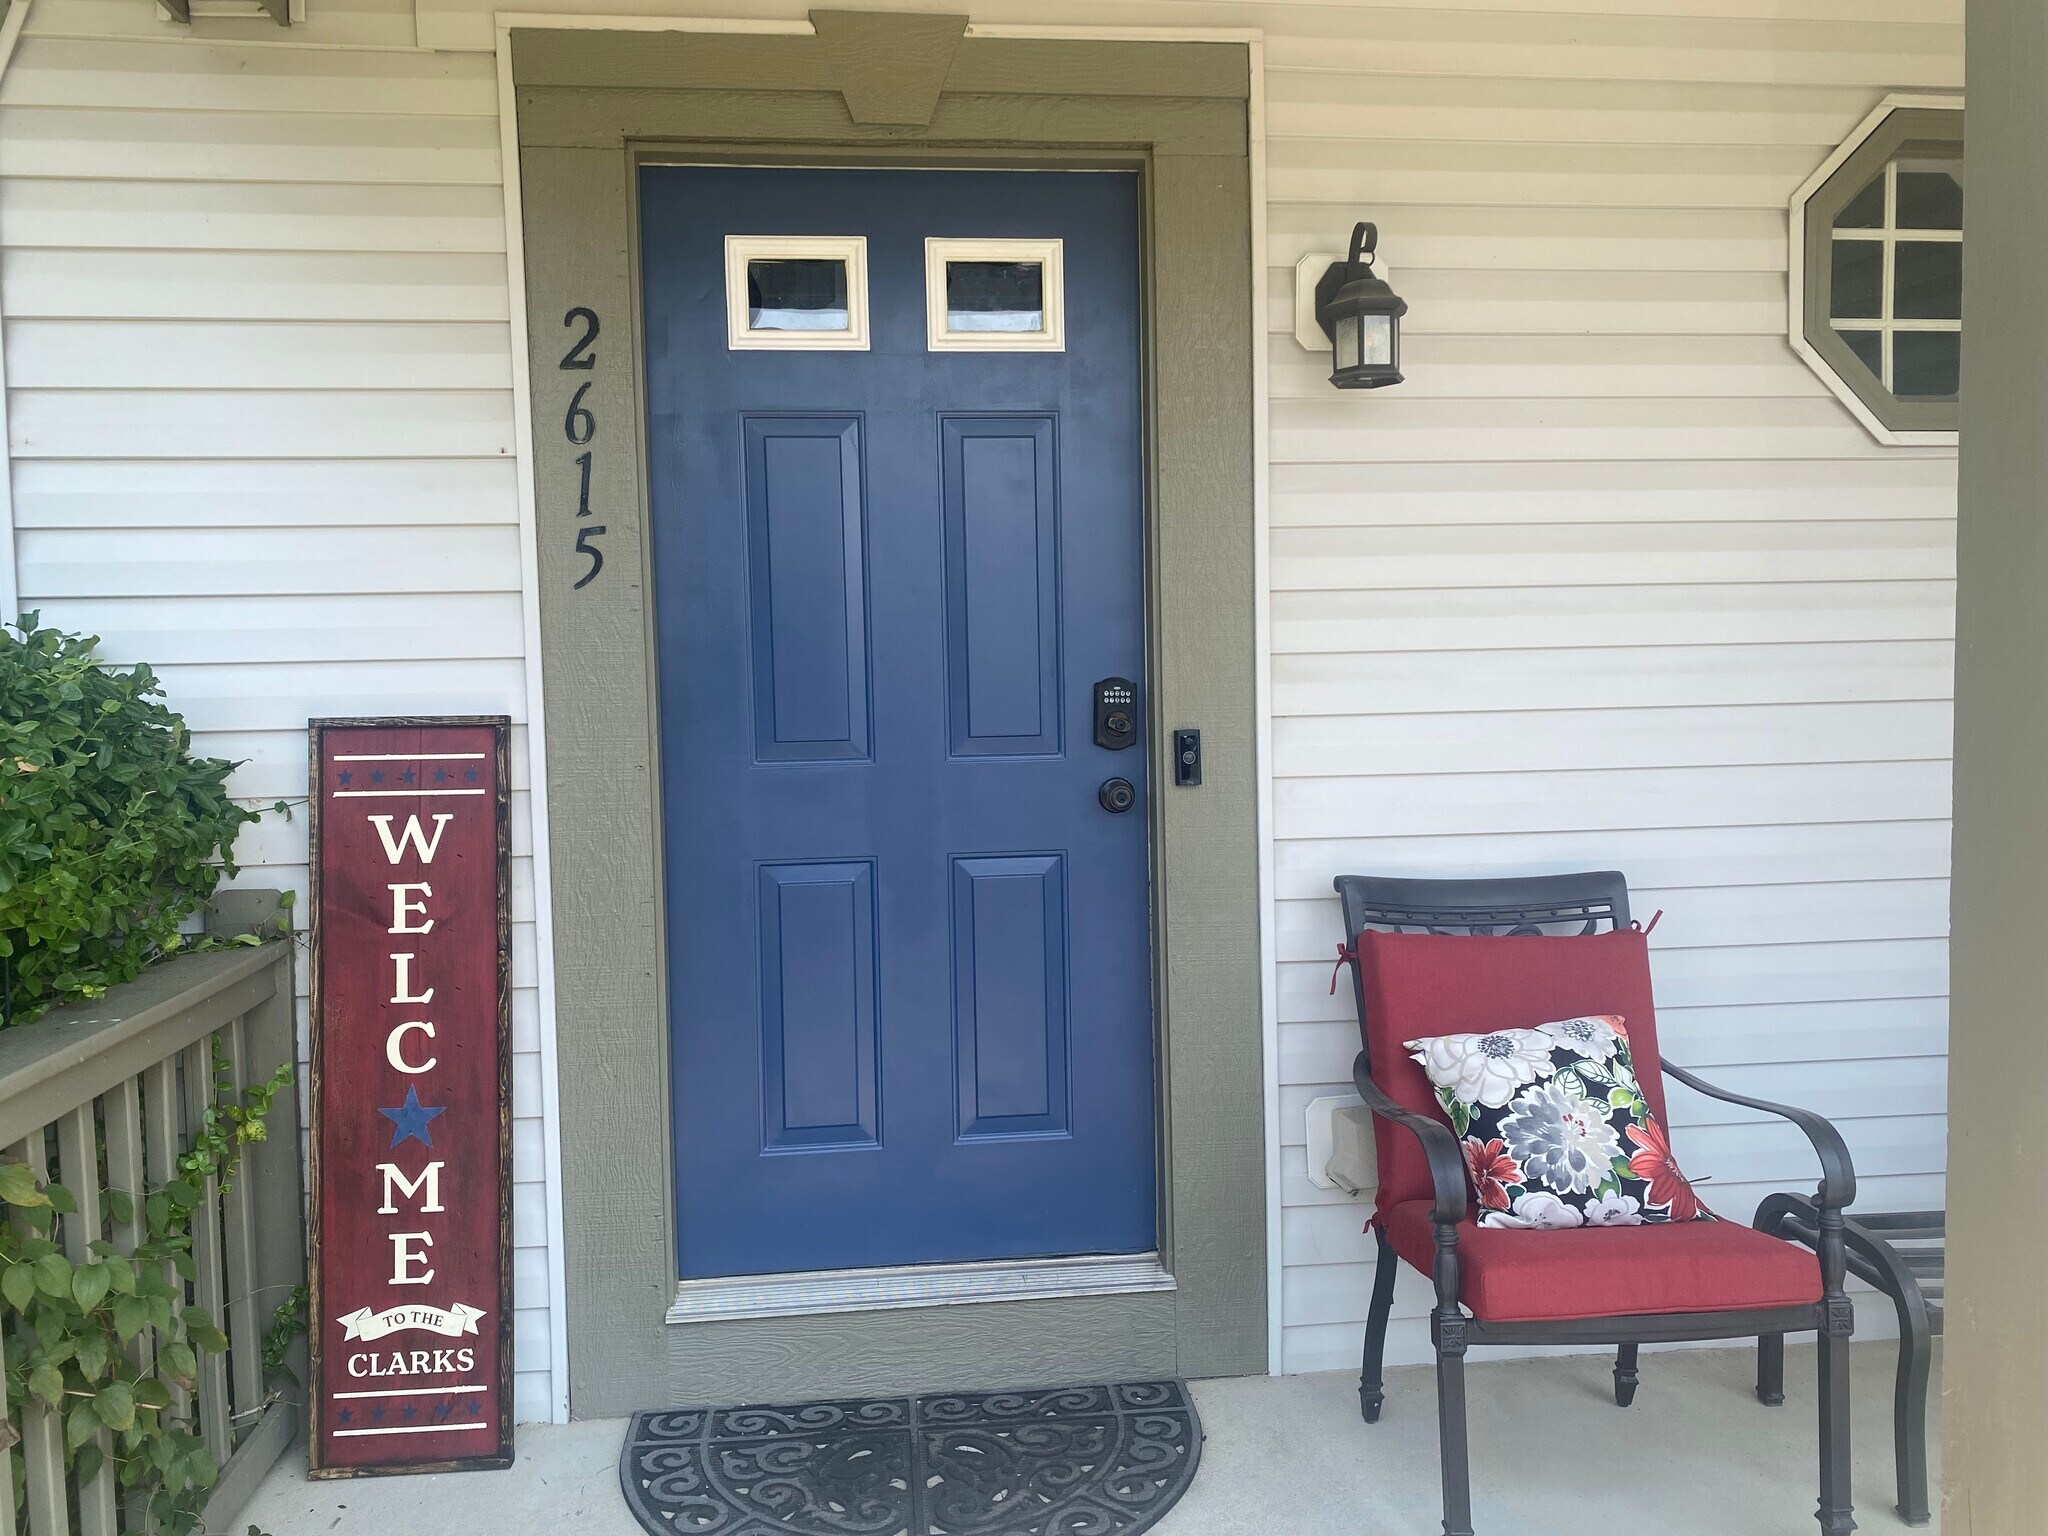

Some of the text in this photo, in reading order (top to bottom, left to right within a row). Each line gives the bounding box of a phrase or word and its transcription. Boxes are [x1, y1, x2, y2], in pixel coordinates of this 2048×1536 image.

[559, 306, 607, 590] 2615
[367, 812, 454, 1286] WELCME
[347, 1348, 475, 1378] CLARKS
[382, 1311, 444, 1328] TO THE
